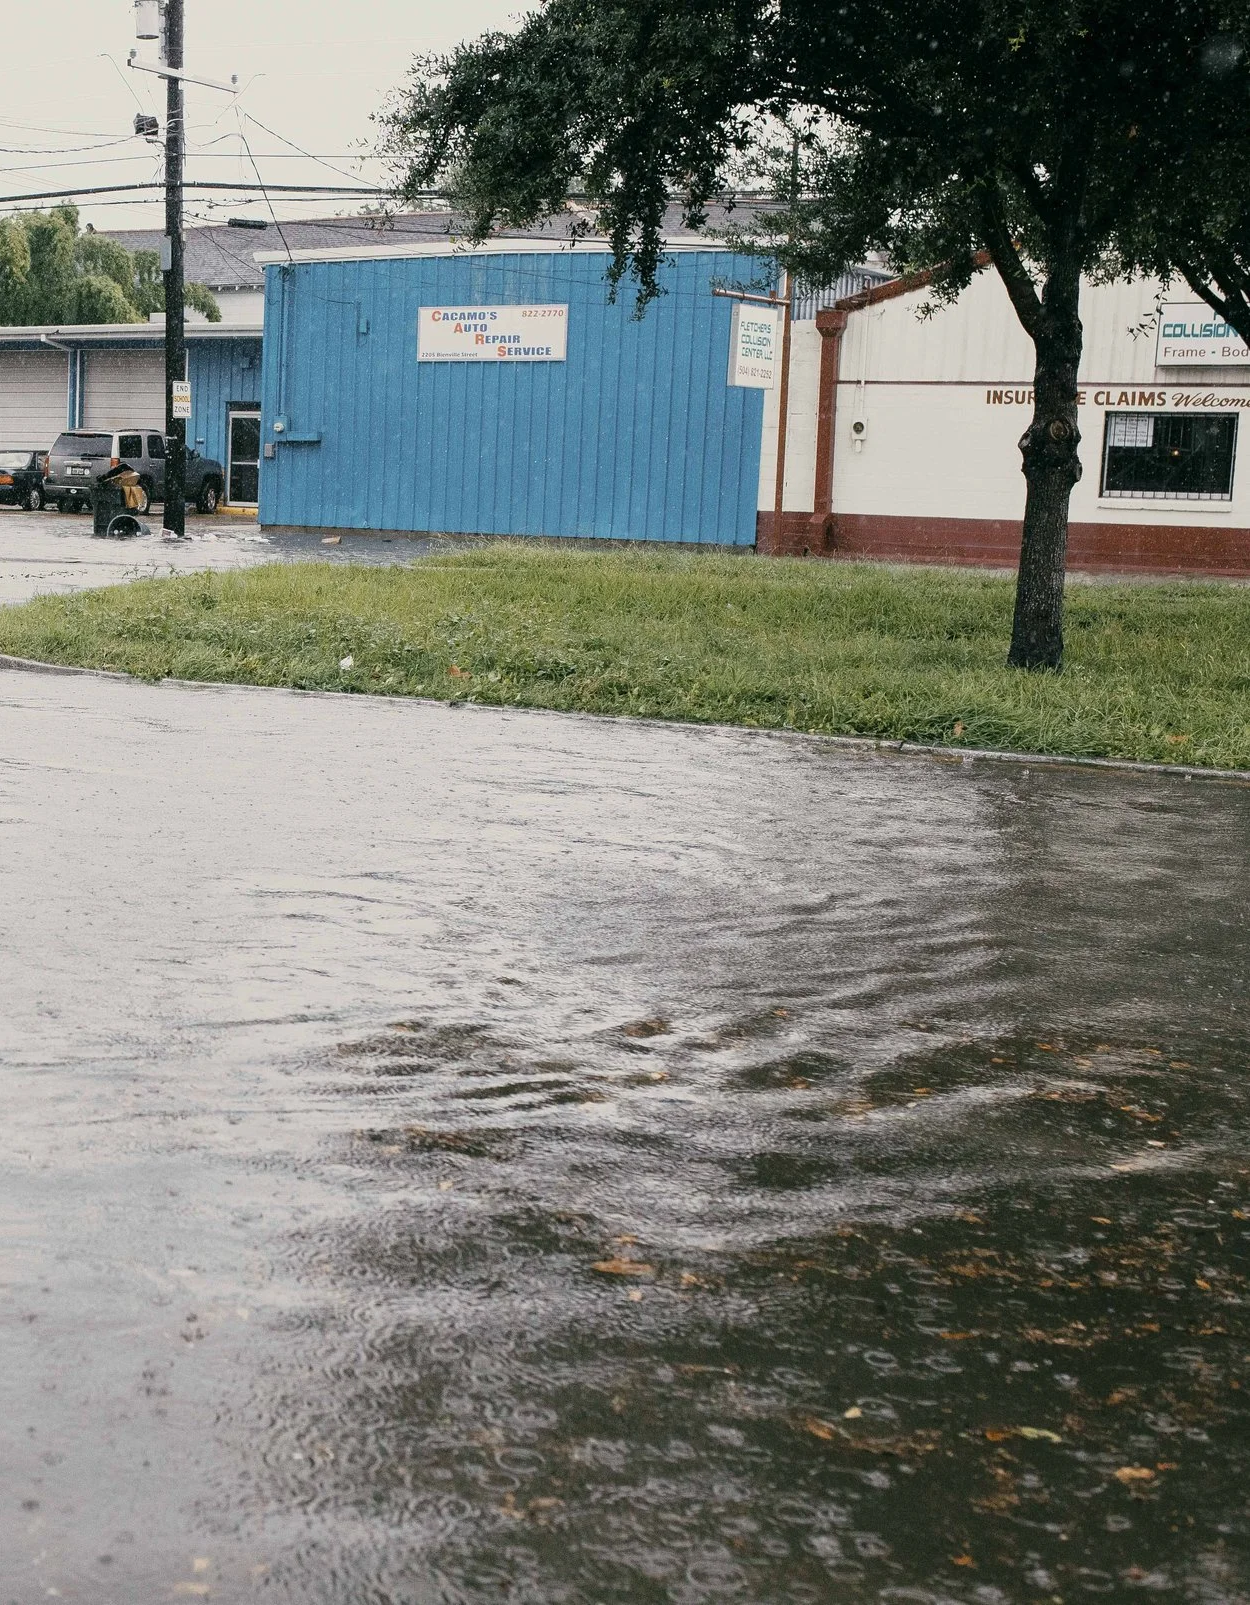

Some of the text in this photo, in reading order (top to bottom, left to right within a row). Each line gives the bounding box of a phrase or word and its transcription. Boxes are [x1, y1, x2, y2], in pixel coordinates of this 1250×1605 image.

[432, 311, 498, 322] CACAMO'S
[522, 309, 564, 318] 822-2770
[454, 322, 488, 334] AUTO
[1162, 323, 1239, 338] COLLISION
[475, 333, 521, 345] REPAIR
[741, 334, 771, 347] COLLISION
[497, 345, 552, 357] SERVICE
[741, 346, 764, 359] CENTER
[1163, 346, 1206, 357] Frame
[174, 395, 190, 403] SCHOOL
[986, 390, 1087, 405] INSURE
[1094, 391, 1167, 407] CLAIMS
